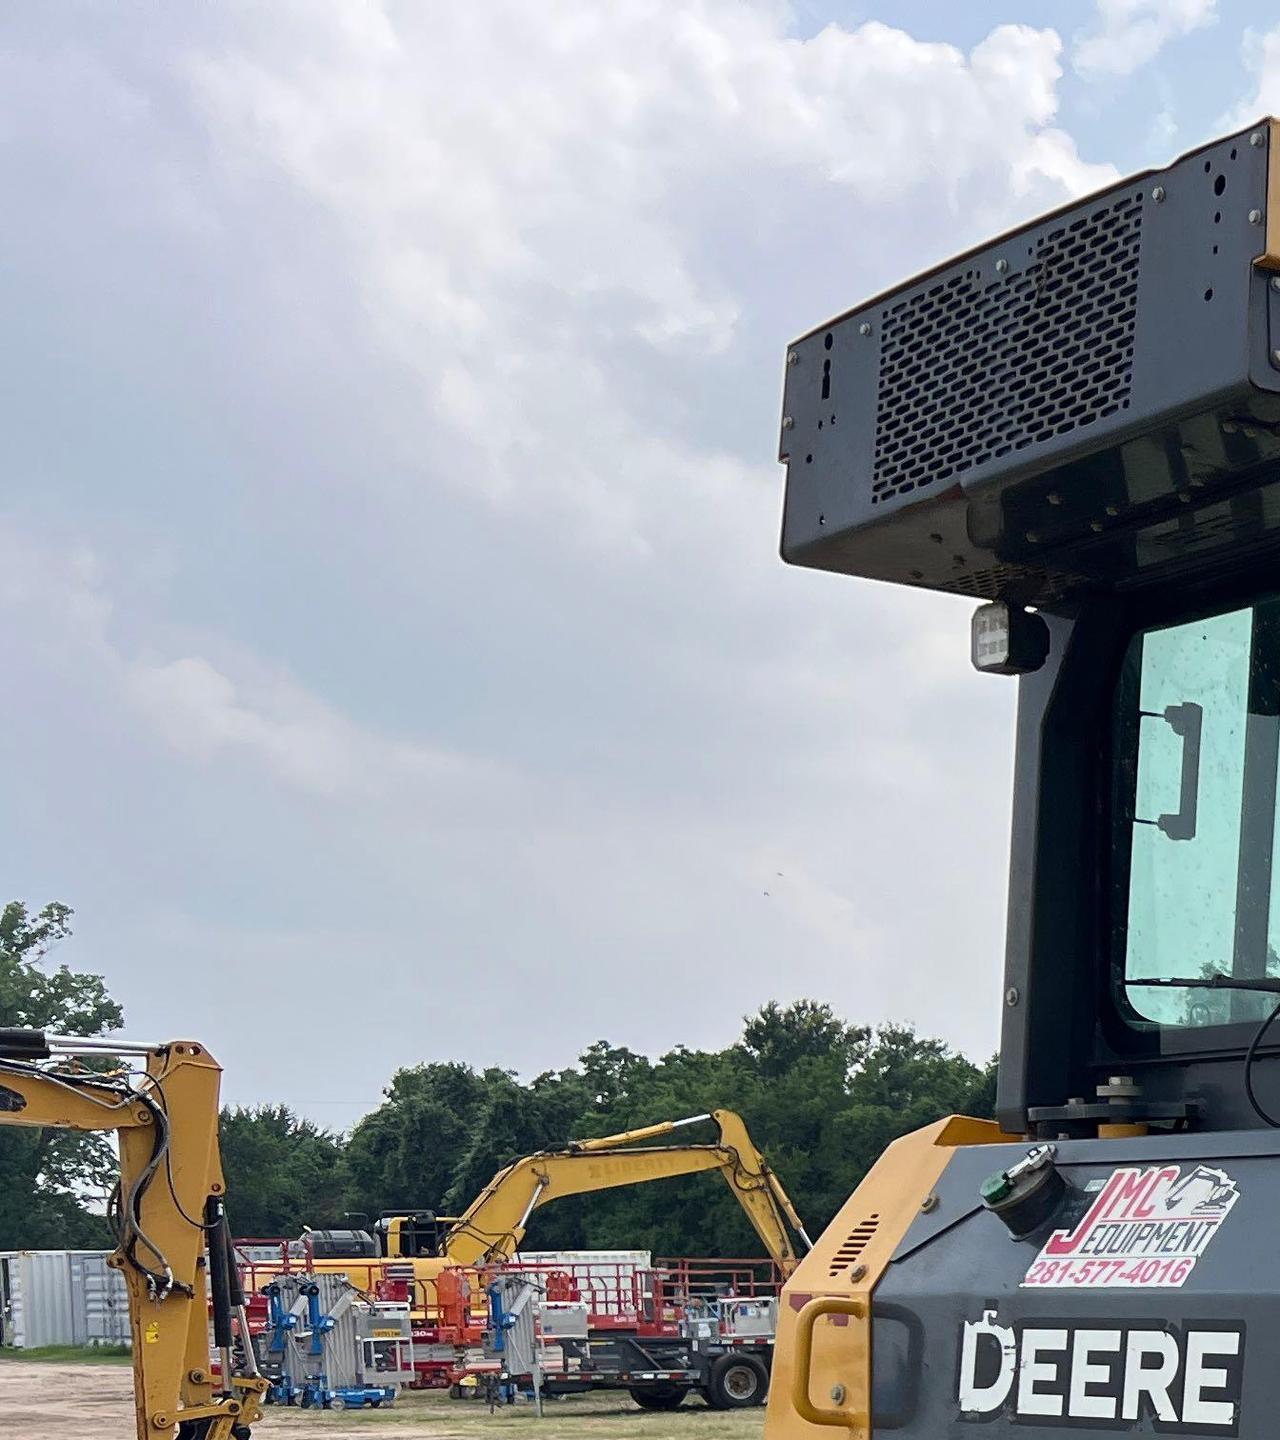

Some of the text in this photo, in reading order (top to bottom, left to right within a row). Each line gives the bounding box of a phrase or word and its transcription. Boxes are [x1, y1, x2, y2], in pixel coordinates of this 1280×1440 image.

[1045, 1169, 1178, 1255] JMC
[1078, 1221, 1220, 1255] EQUIPMENT
[1024, 1258, 1192, 1285] 281-577-4016
[958, 1309, 1241, 1426] DEERE
